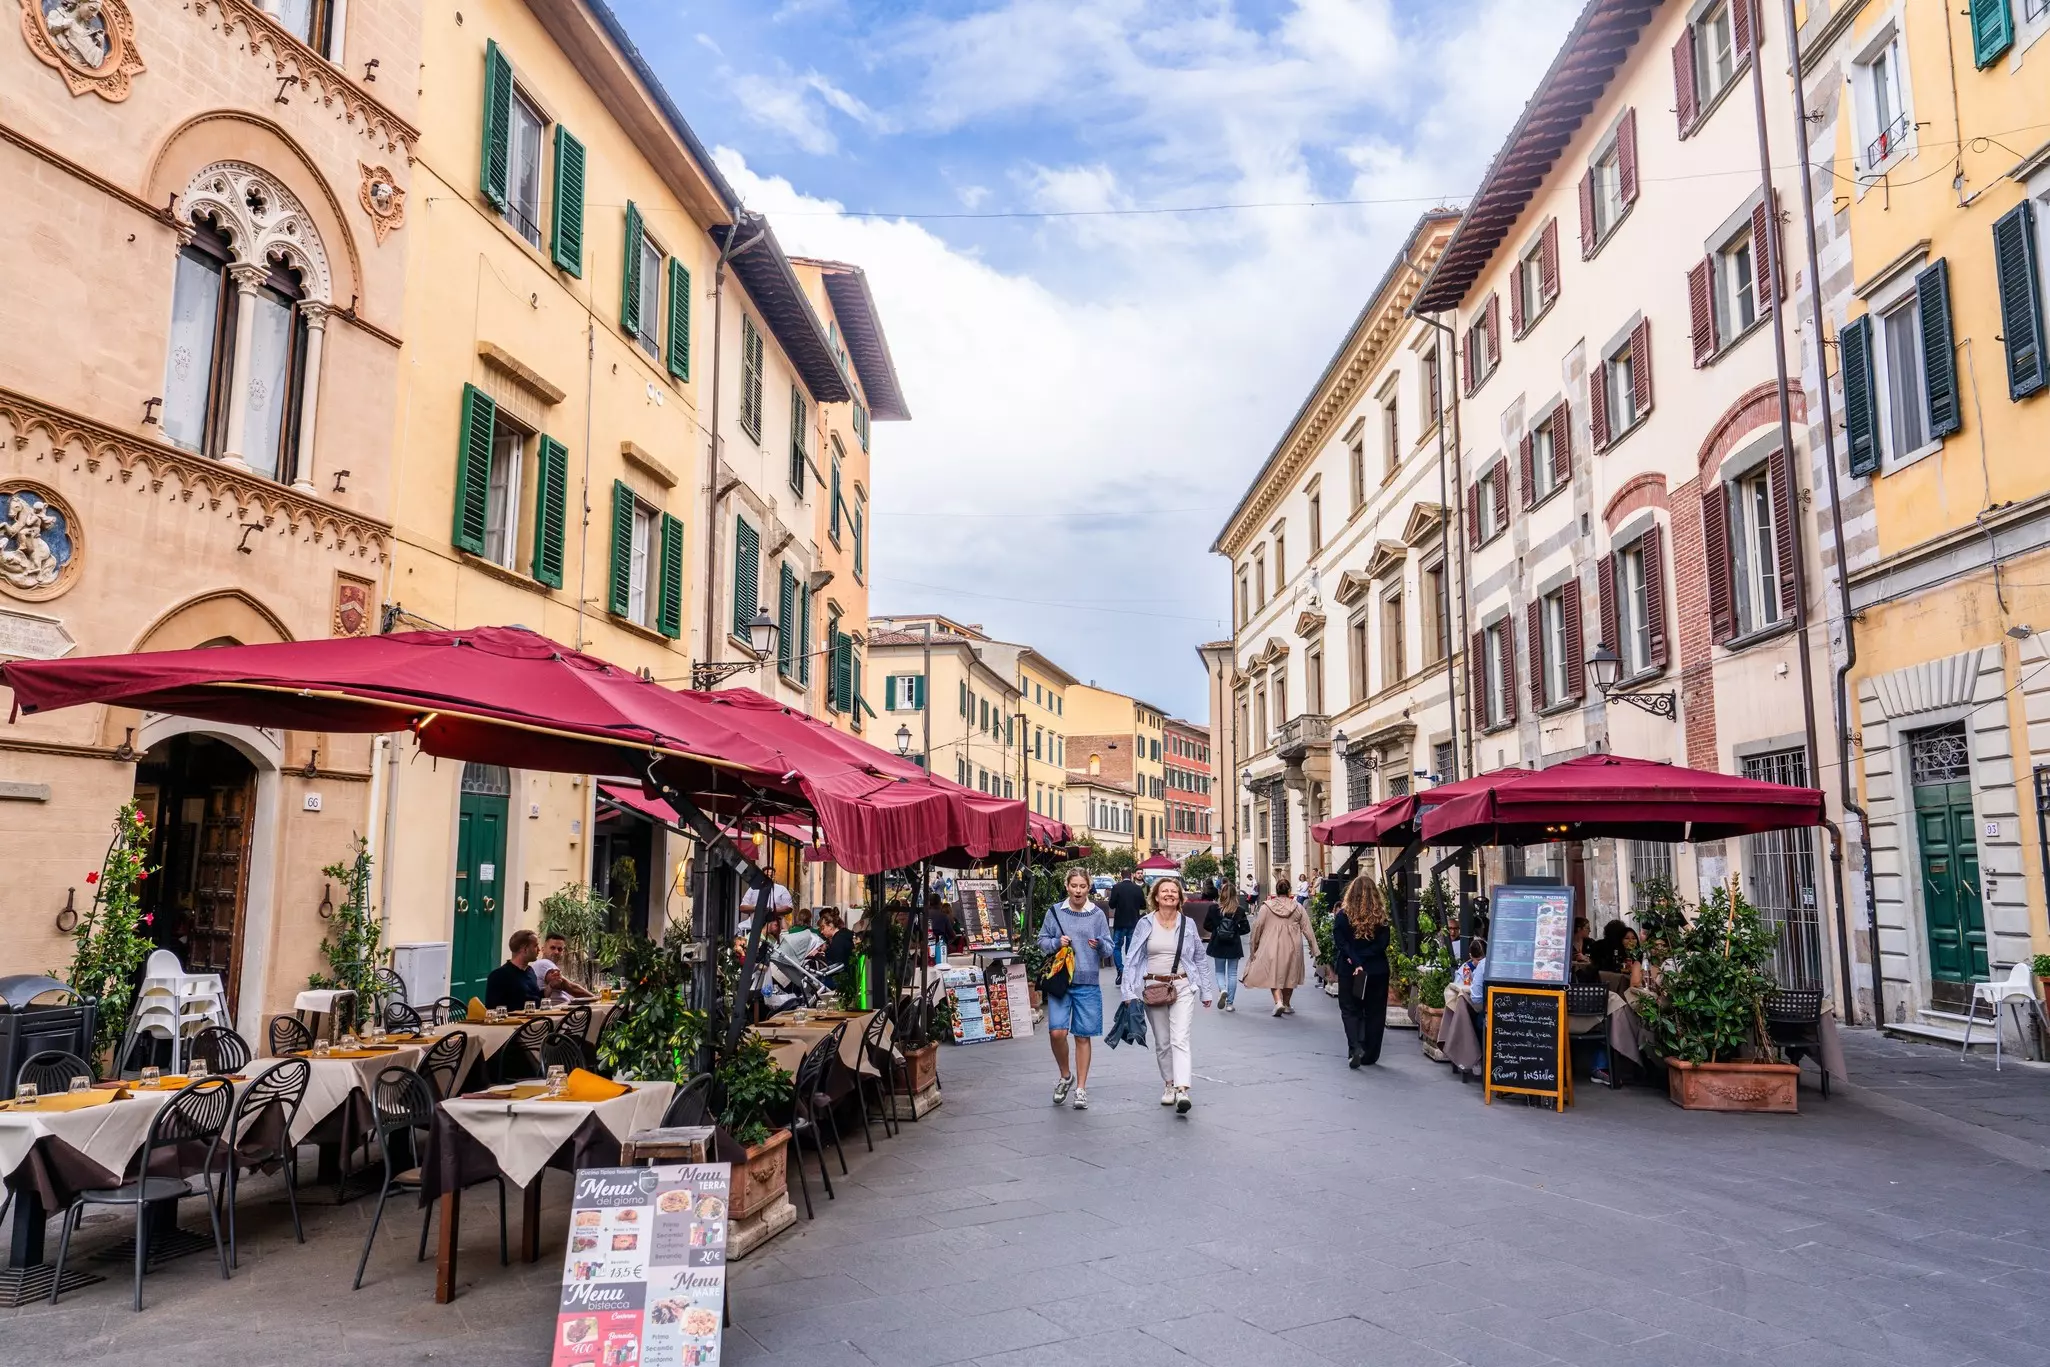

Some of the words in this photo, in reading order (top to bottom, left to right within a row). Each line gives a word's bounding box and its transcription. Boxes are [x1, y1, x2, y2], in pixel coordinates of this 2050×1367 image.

[308, 797, 318, 808] 66
[1987, 824, 1997, 835] 93
[674, 1167, 723, 1184] Menu
[699, 1180, 727, 1190] TERRA
[596, 1197, 612, 1206] del
[613, 1196, 645, 1207] giorno
[670, 1271, 721, 1291] Menu
[563, 1283, 625, 1306] Menu
[692, 1288, 720, 1297] MARE
[588, 1301, 630, 1311] bistecca
